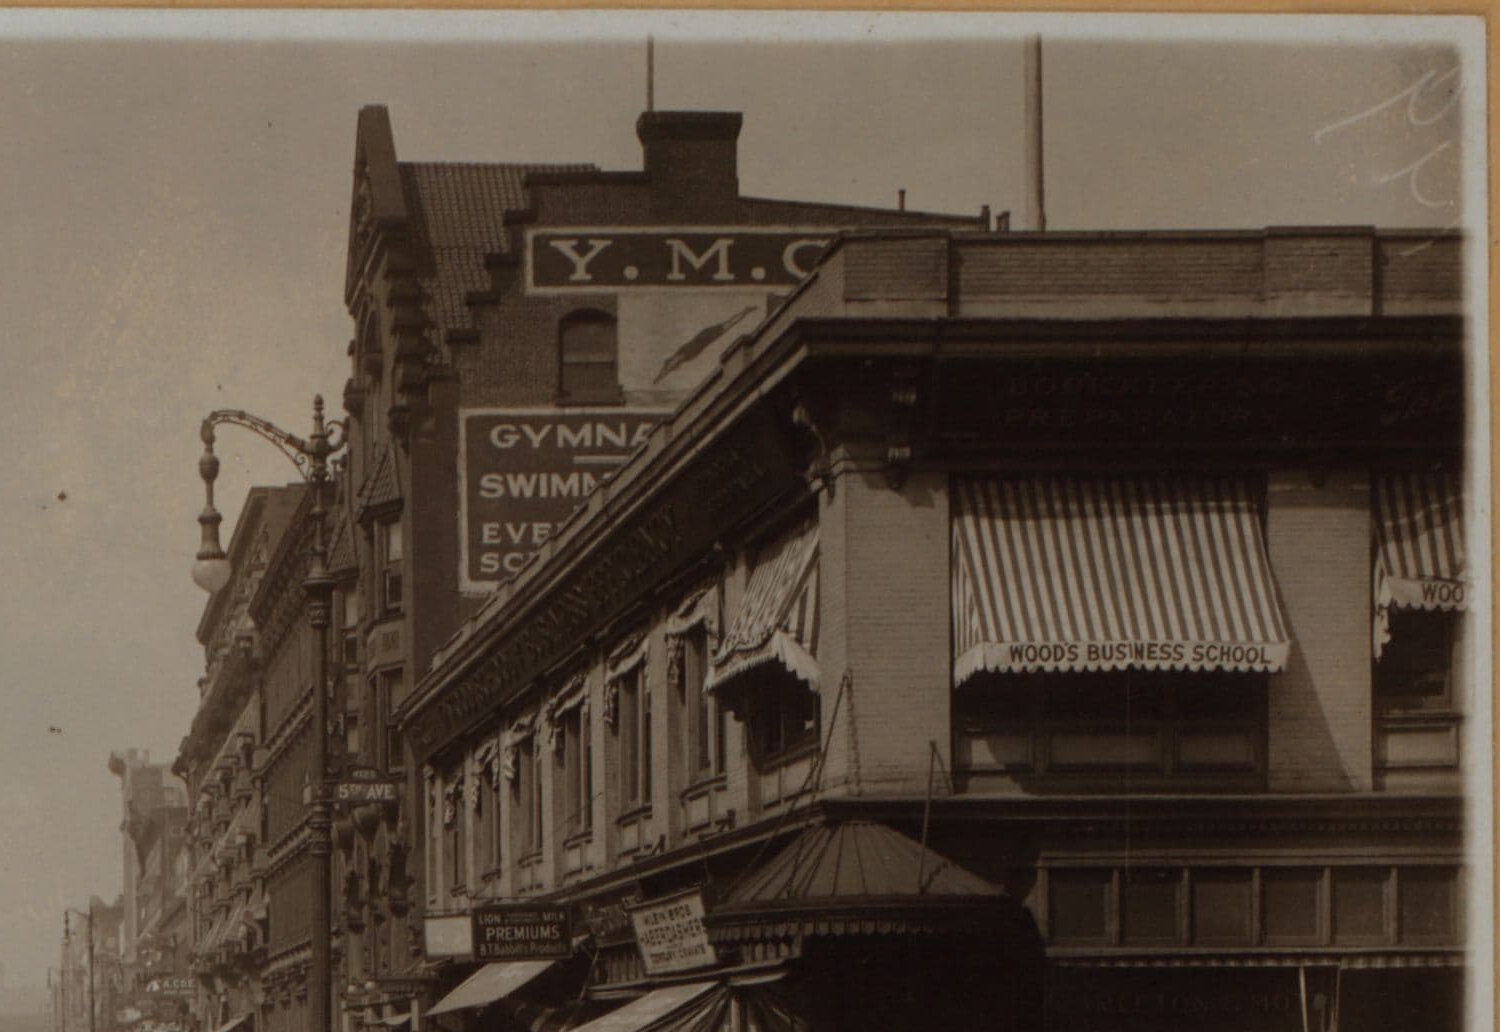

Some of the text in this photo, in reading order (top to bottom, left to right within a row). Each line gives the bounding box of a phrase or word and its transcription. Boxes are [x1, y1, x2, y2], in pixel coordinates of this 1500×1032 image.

[479, 551, 536, 574] SC
[1009, 642, 1272, 665] WOOD'S BUSINESS SCHOOL
[478, 912, 501, 925] LION
[542, 911, 565, 922] MILK
[485, 924, 561, 942] PREMIUMS
